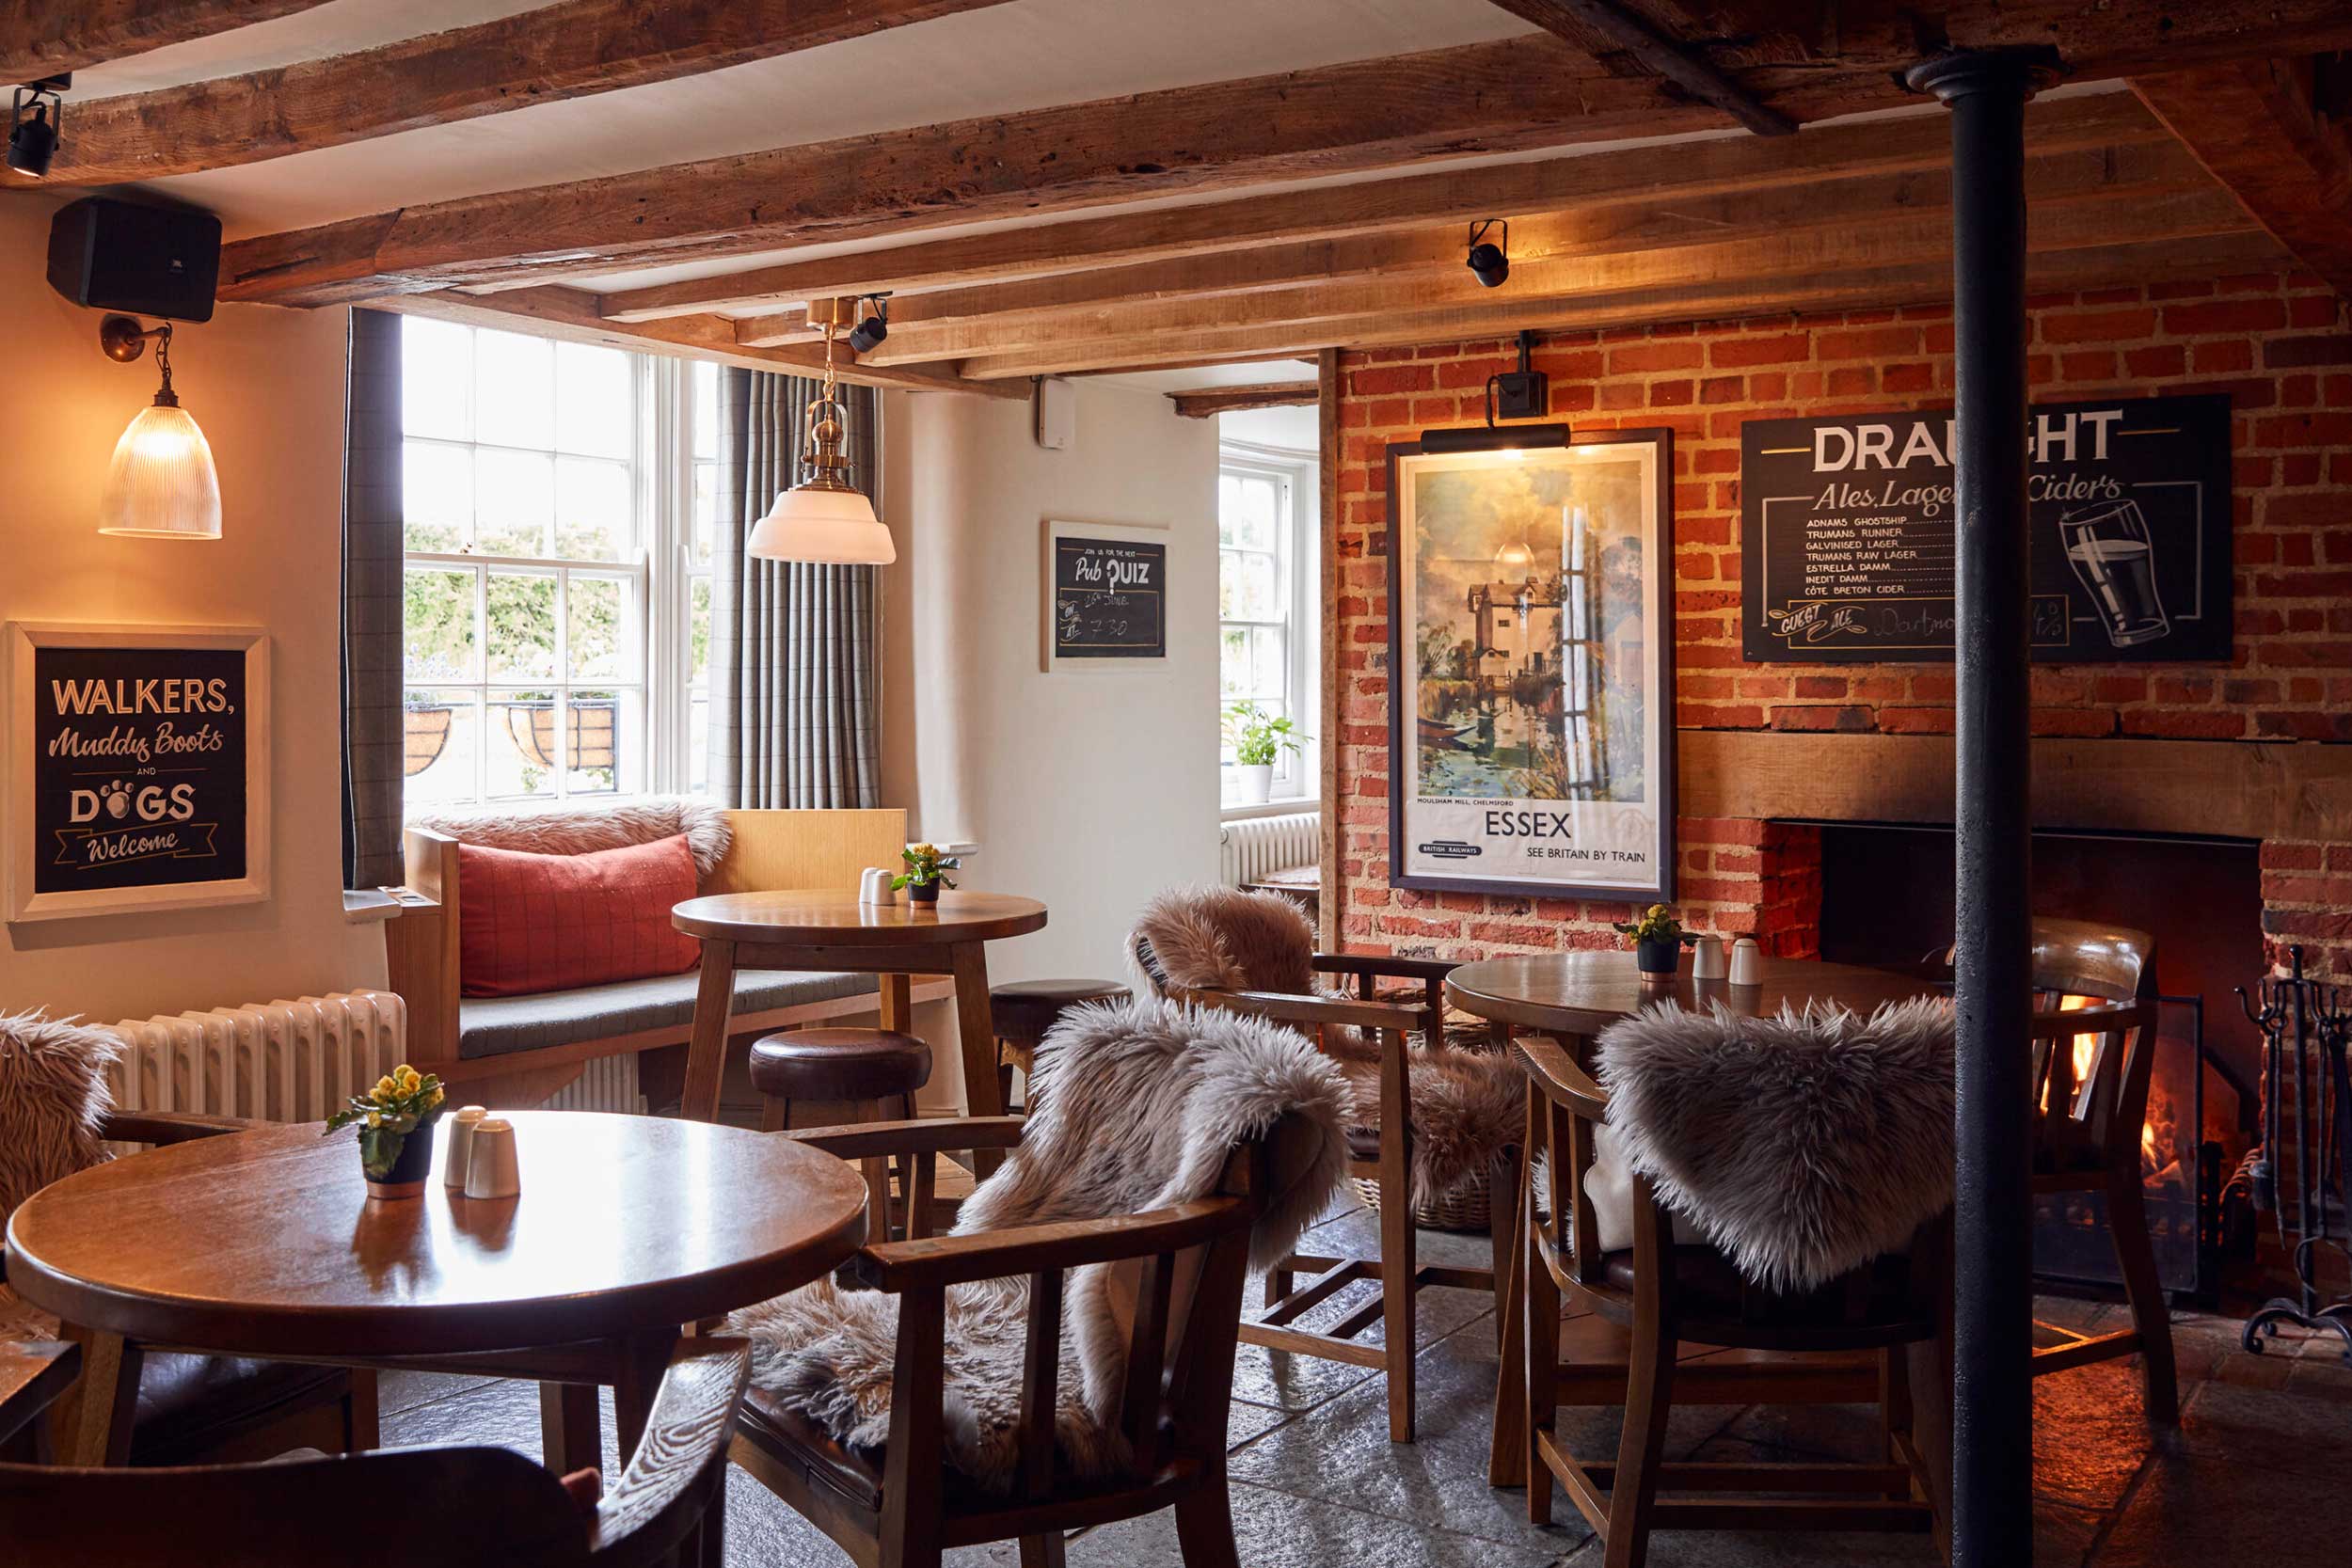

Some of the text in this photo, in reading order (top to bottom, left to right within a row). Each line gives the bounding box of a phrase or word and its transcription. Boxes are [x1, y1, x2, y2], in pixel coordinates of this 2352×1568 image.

[1812, 409, 2123, 472] DRAHT
[1806, 516, 1907, 528] ADNAMS GHOSTSHIP
[1806, 528, 1903, 539] TRUMANS RUNNER
[1805, 539, 1899, 550] GALVINISED LAGER
[1806, 550, 1917, 562] TRUMANS RAW LAGER
[1806, 562, 1890, 573] ESTRELLA DAMM
[1075, 557, 1150, 595] Pub QUIZ
[1805, 574, 1867, 584] INEDIT DAMM
[1804, 585, 1905, 596] CÔTE BRETON CIDER
[1781, 603, 1853, 634] GUEST ALE
[52, 678, 234, 716] WALKERS,
[49, 721, 224, 763] Muddy Boots
[137, 767, 156, 776] AND
[1486, 810, 1571, 838] ESSEX
[87, 832, 179, 863] Welcome
[1527, 847, 1645, 863] SEE BRITAIN BY TRAIN
